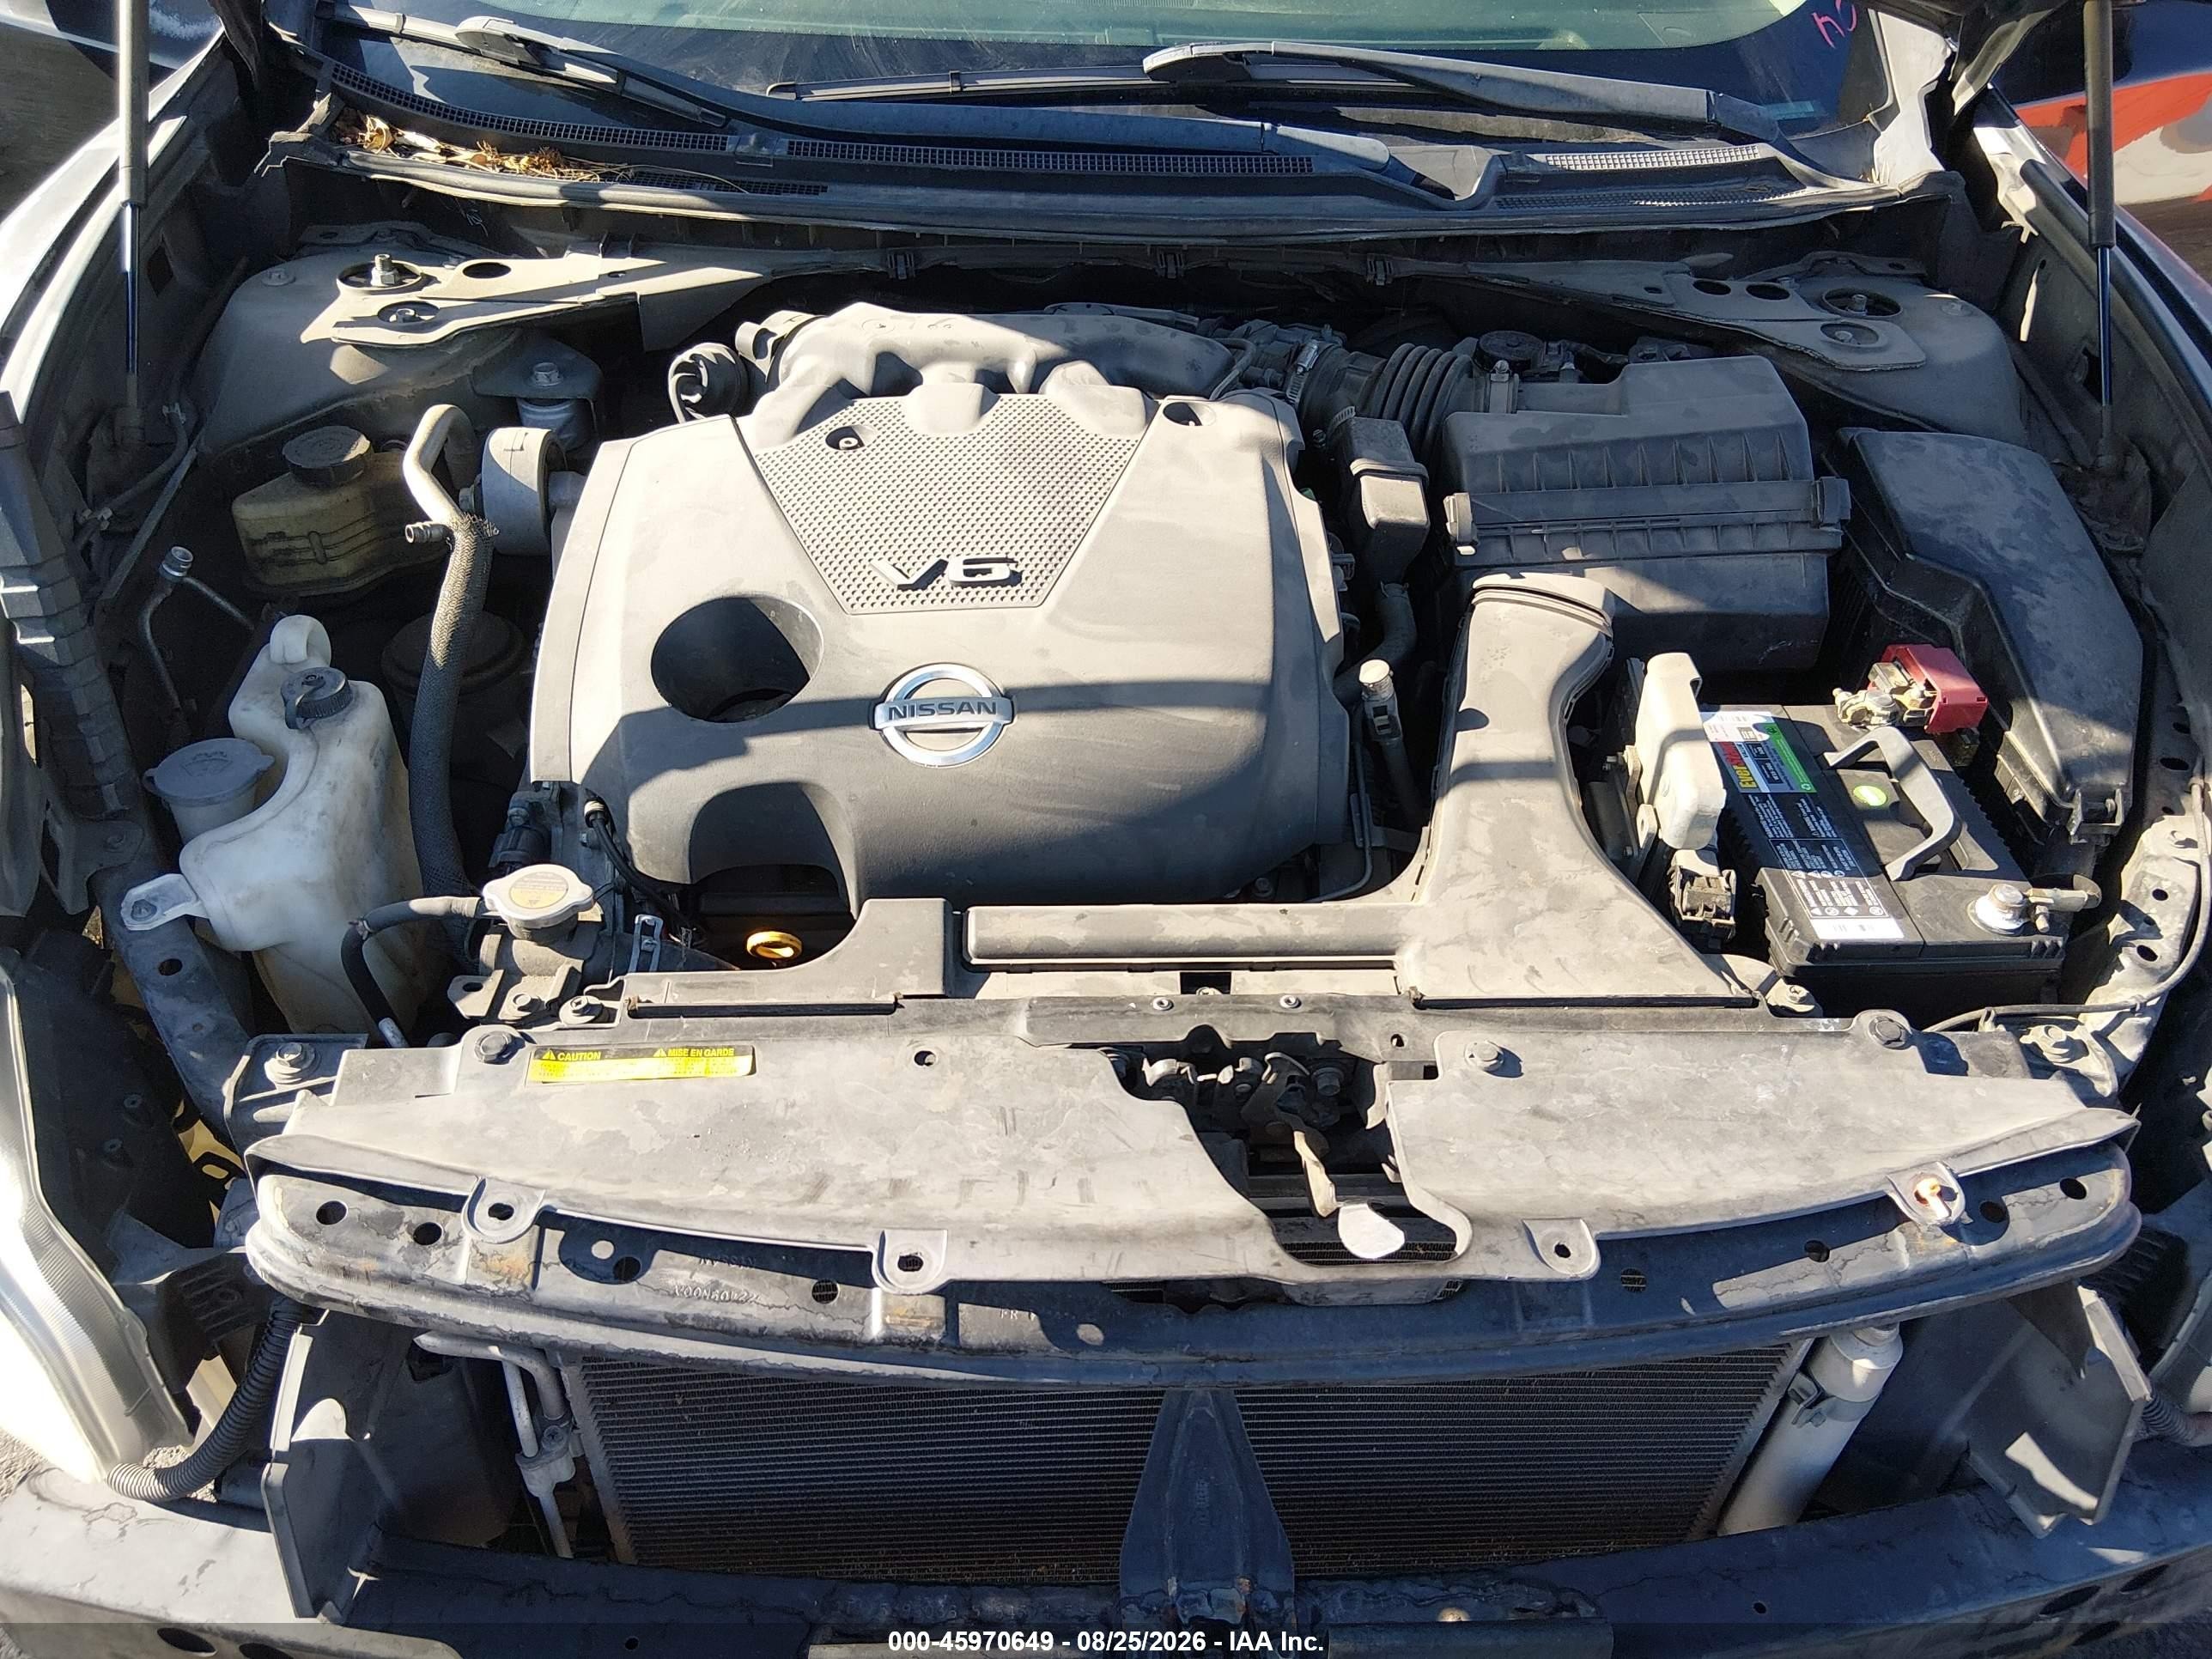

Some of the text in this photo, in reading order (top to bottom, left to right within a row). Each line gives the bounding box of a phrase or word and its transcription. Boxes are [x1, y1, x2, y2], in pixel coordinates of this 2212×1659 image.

[868, 555, 1017, 587] V6
[888, 701, 997, 720] NISSAN
[558, 1051, 601, 1061] CAUTION
[667, 1048, 735, 1058] MISE EN GARDE
